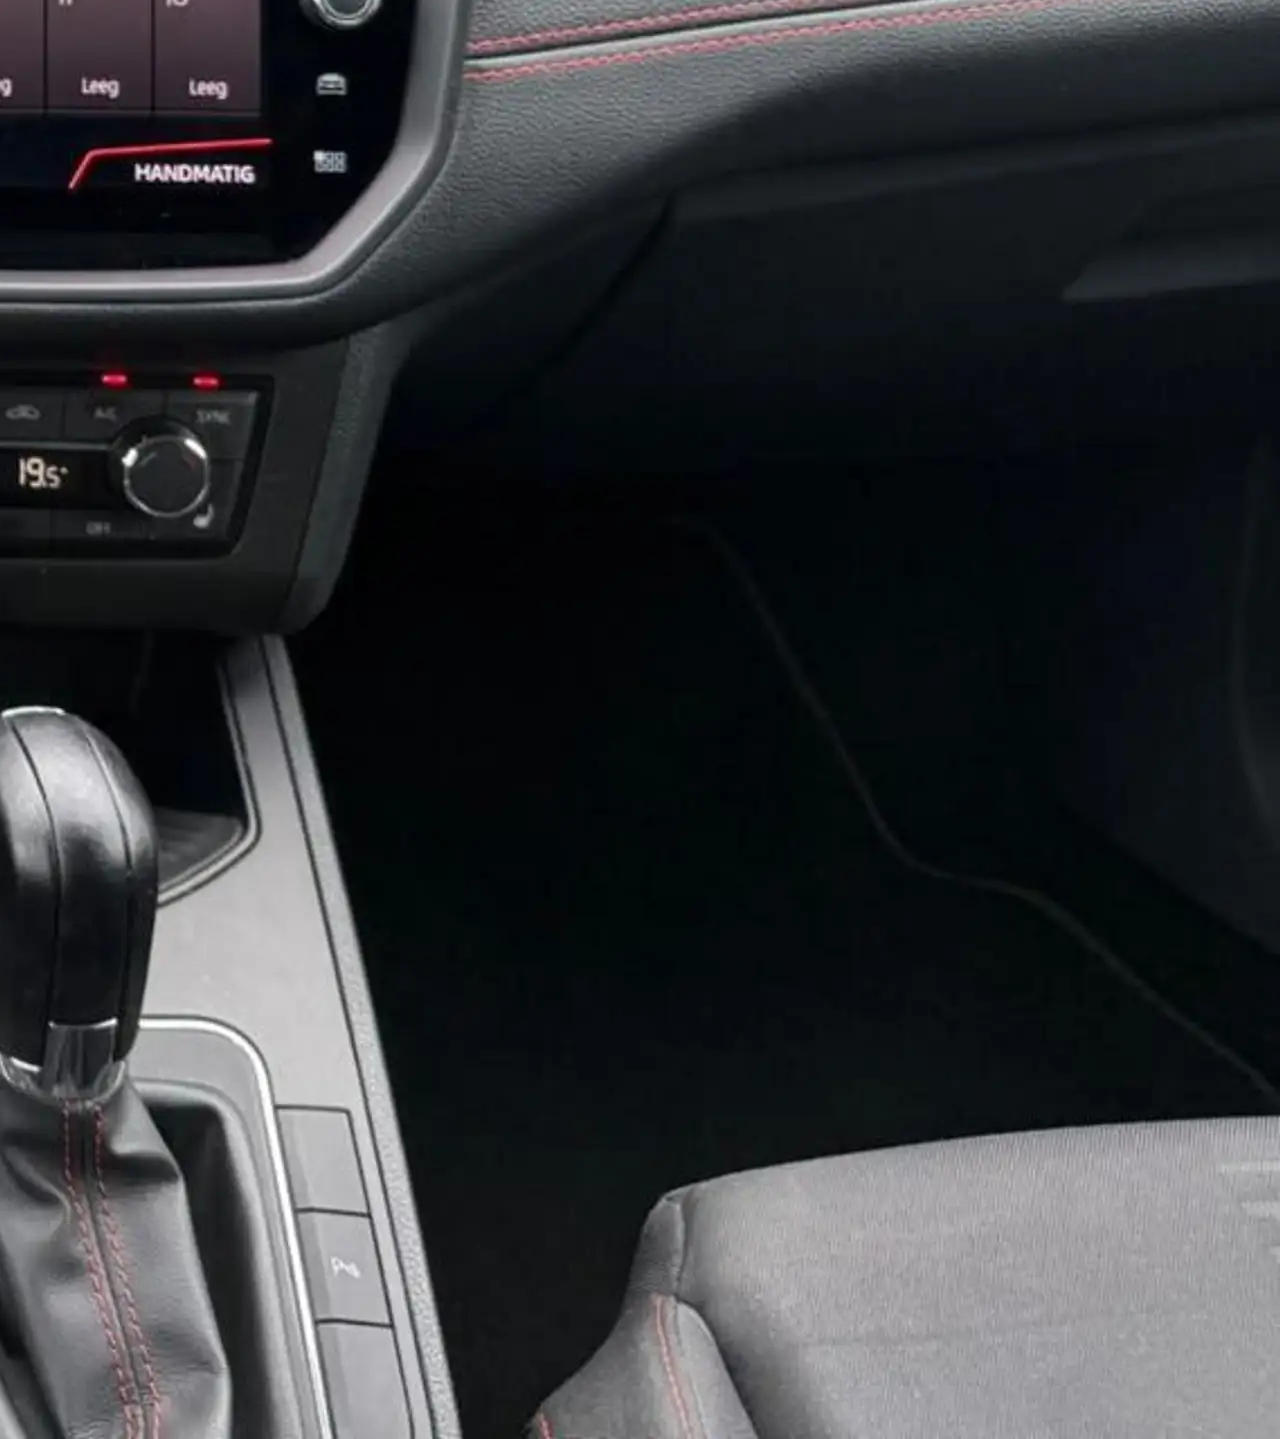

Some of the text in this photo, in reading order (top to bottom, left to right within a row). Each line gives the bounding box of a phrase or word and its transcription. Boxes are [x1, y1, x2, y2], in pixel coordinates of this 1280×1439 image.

[82, 79, 119, 98] Leeg
[189, 81, 227, 99] Leeg
[135, 164, 255, 183] HANDMATIG
